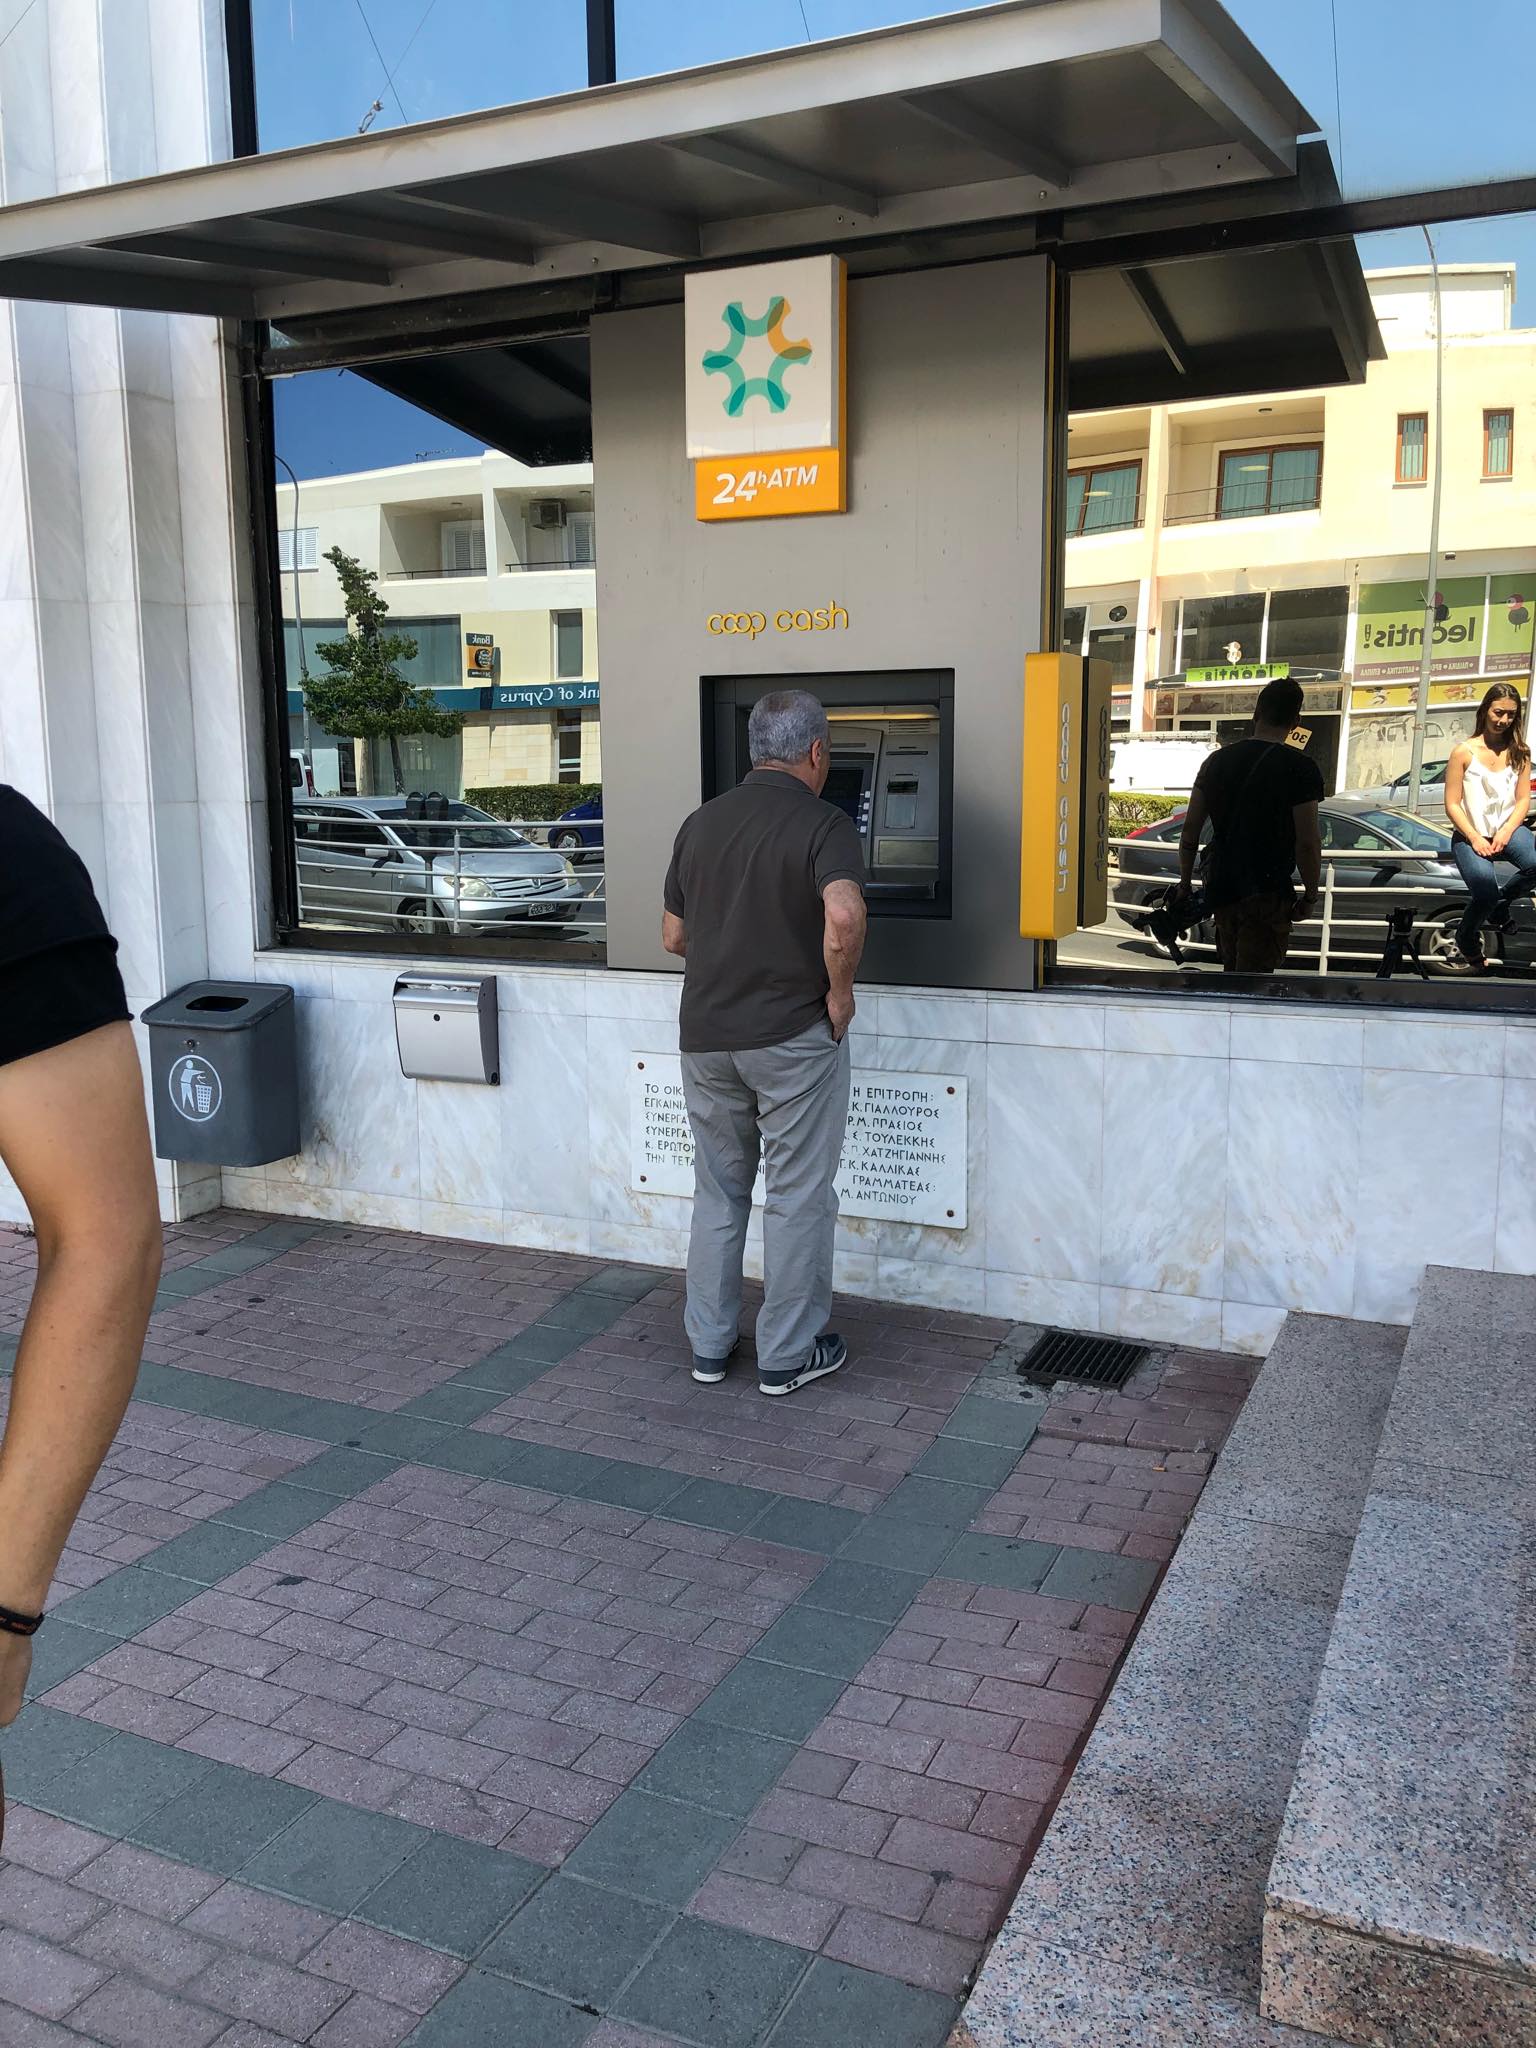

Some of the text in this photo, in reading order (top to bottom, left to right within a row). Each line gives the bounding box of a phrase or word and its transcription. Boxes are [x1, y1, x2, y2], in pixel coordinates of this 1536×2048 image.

[706, 600, 849, 641] coop cash
[644, 1083, 682, 1096] ΤΟ ΟΙΚ
[853, 1086, 934, 1102] Η ΕΠΙΤΡΟΠΗ:
[644, 1097, 688, 1111] ΕΓΚΑΙΝΙΑ
[645, 1111, 687, 1124] ΣΥΝΕΡΓΑ
[646, 1126, 693, 1139] ΣΥΝΕΡΓΑΤ
[646, 1152, 696, 1167] ΤΗΝ ΤΕΤΑ
